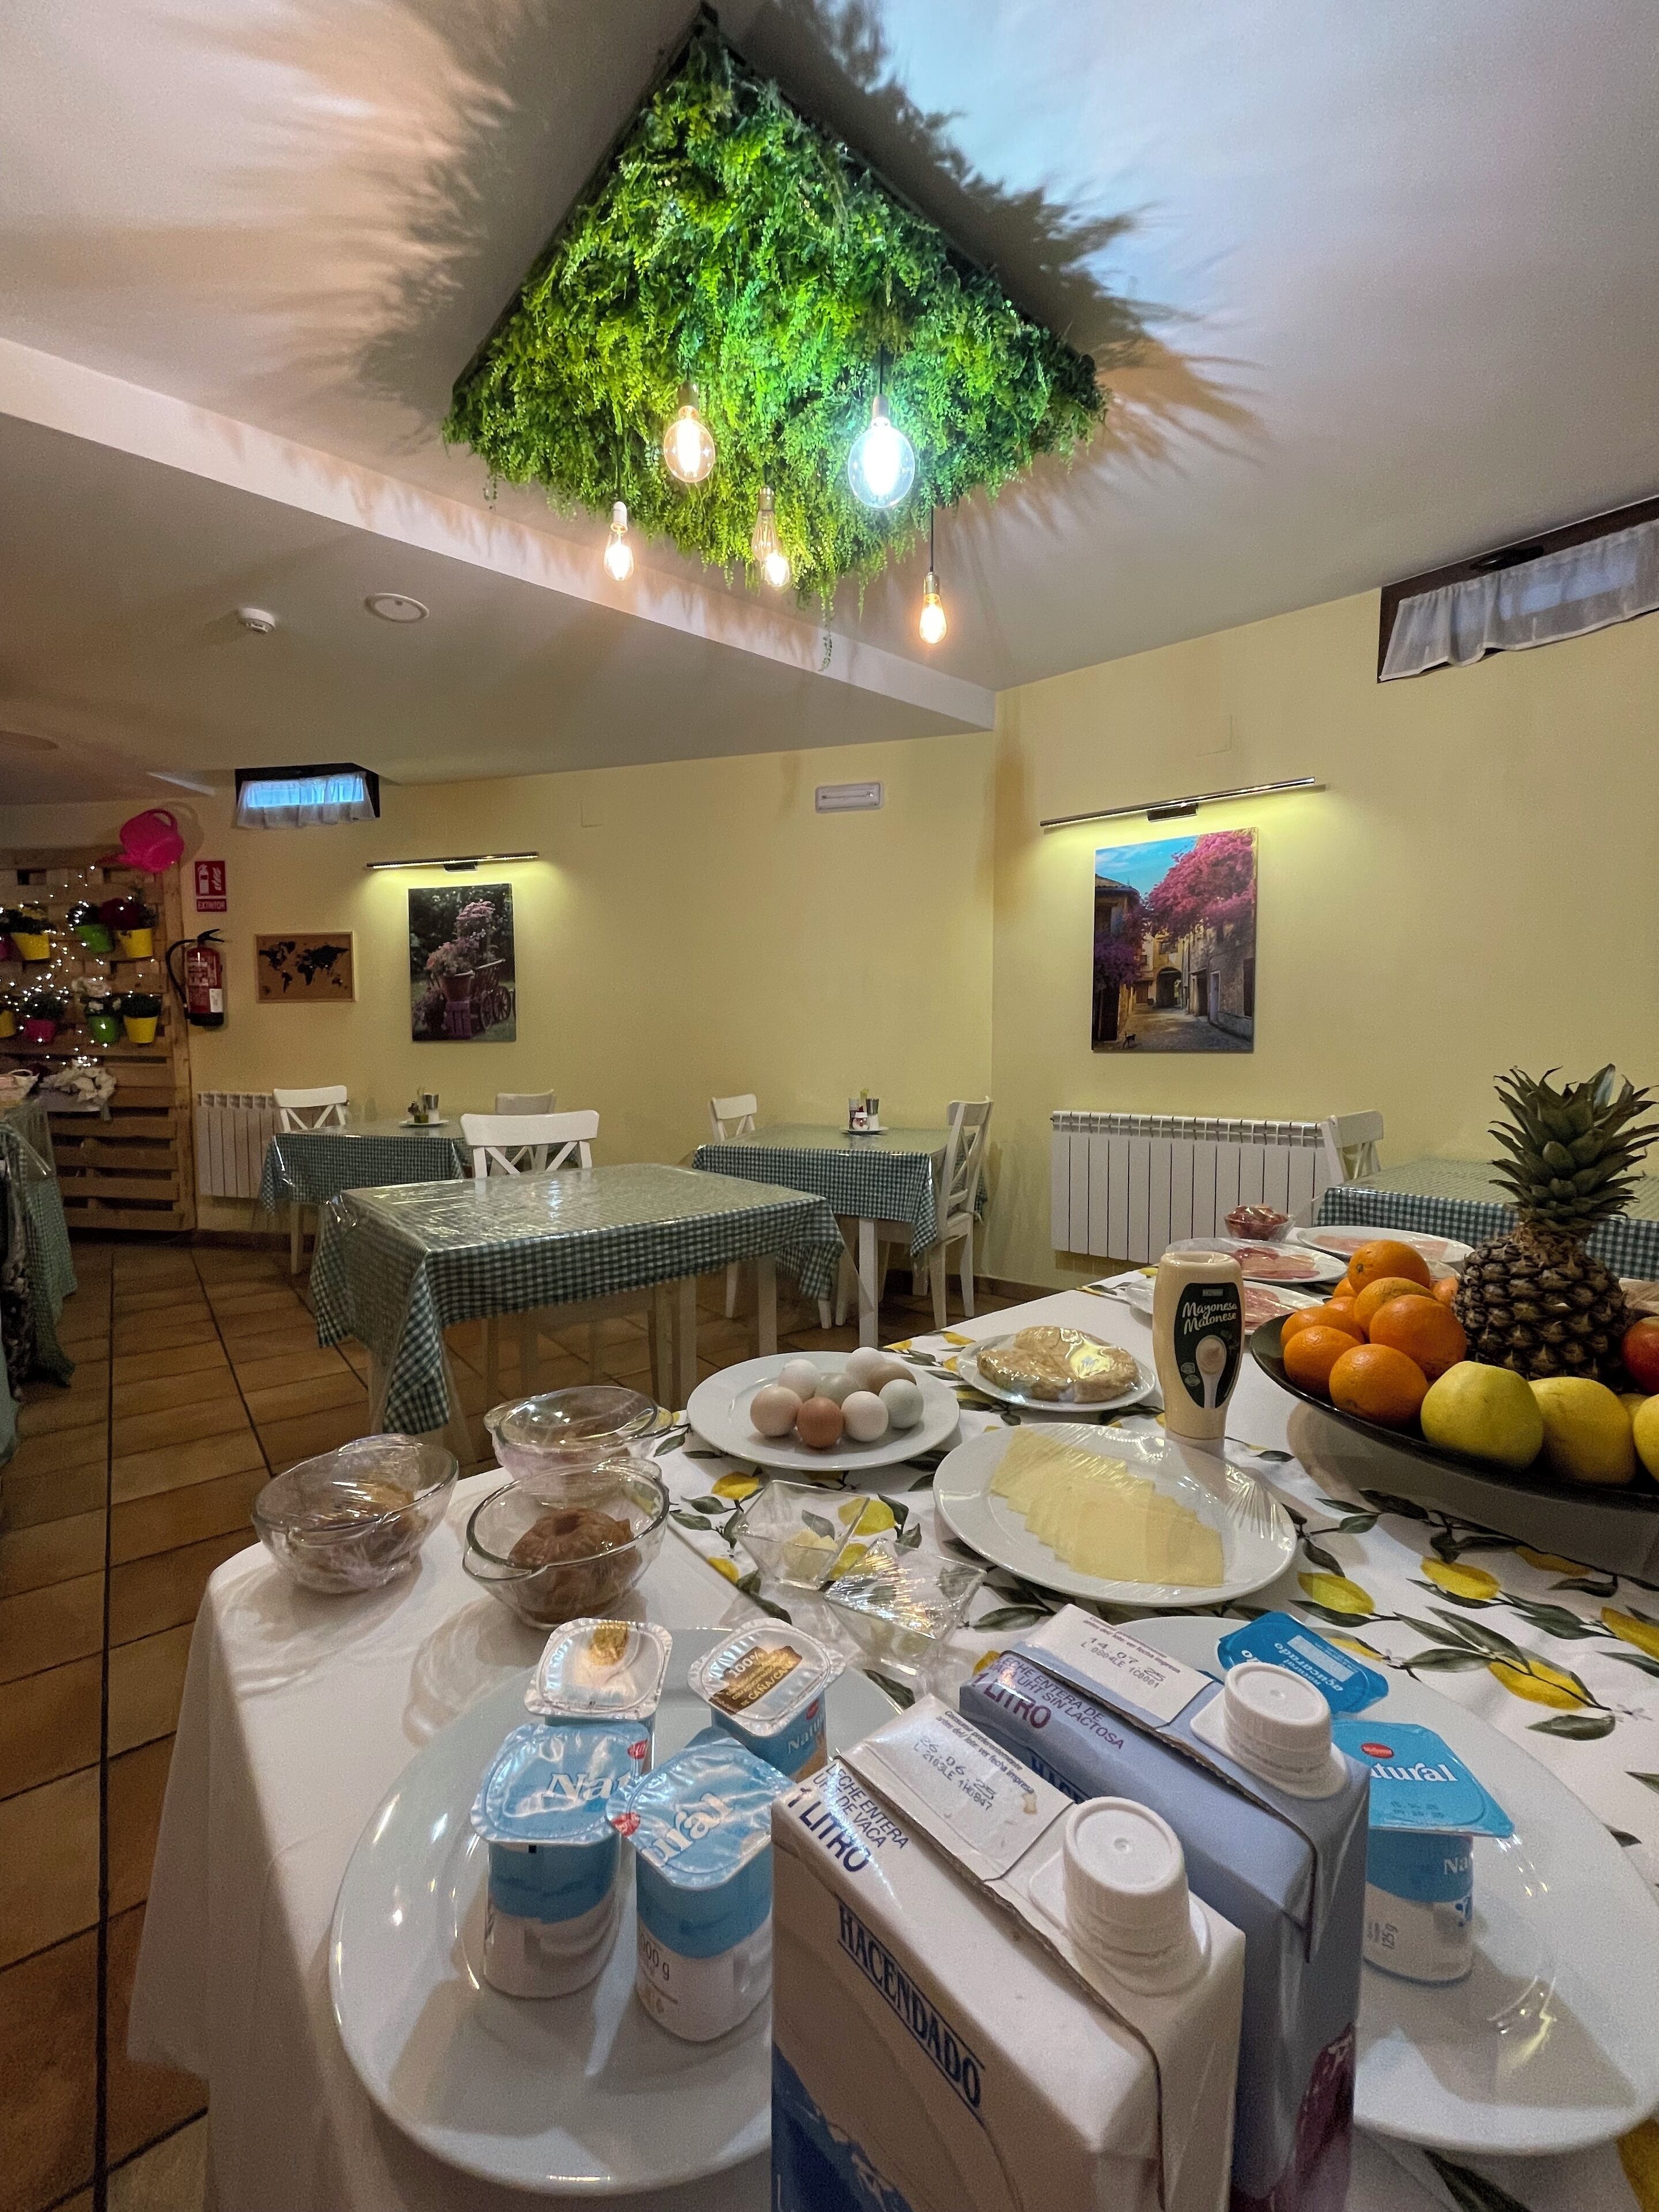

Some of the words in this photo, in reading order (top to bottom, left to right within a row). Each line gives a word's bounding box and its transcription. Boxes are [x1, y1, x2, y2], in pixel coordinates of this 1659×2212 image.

[1182, 1301, 1238, 1320] Mayonesa
[729, 1651, 764, 1677] 100%
[972, 1672, 990, 1687] 1
[983, 1679, 1052, 1729] LITRO
[1017, 1676, 1045, 1694] UHT
[1042, 1691, 1066, 1709] SIN
[1065, 1705, 1125, 1750] LACTOSA
[1033, 1672, 1082, 1709] ENTERA
[1082, 1706, 1105, 1722] DE
[787, 1787, 812, 1808] 1
[988, 1755, 1007, 1772] fecha
[1006, 1768, 1035, 1794] impresa
[825, 1763, 862, 1802] LECHE
[859, 1798, 909, 1849] ENTERA
[835, 1795, 858, 1816] DE
[853, 1813, 887, 1848] VACA
[798, 1801, 872, 1872] LITRO
[839, 1901, 982, 2108] HACENDADO
